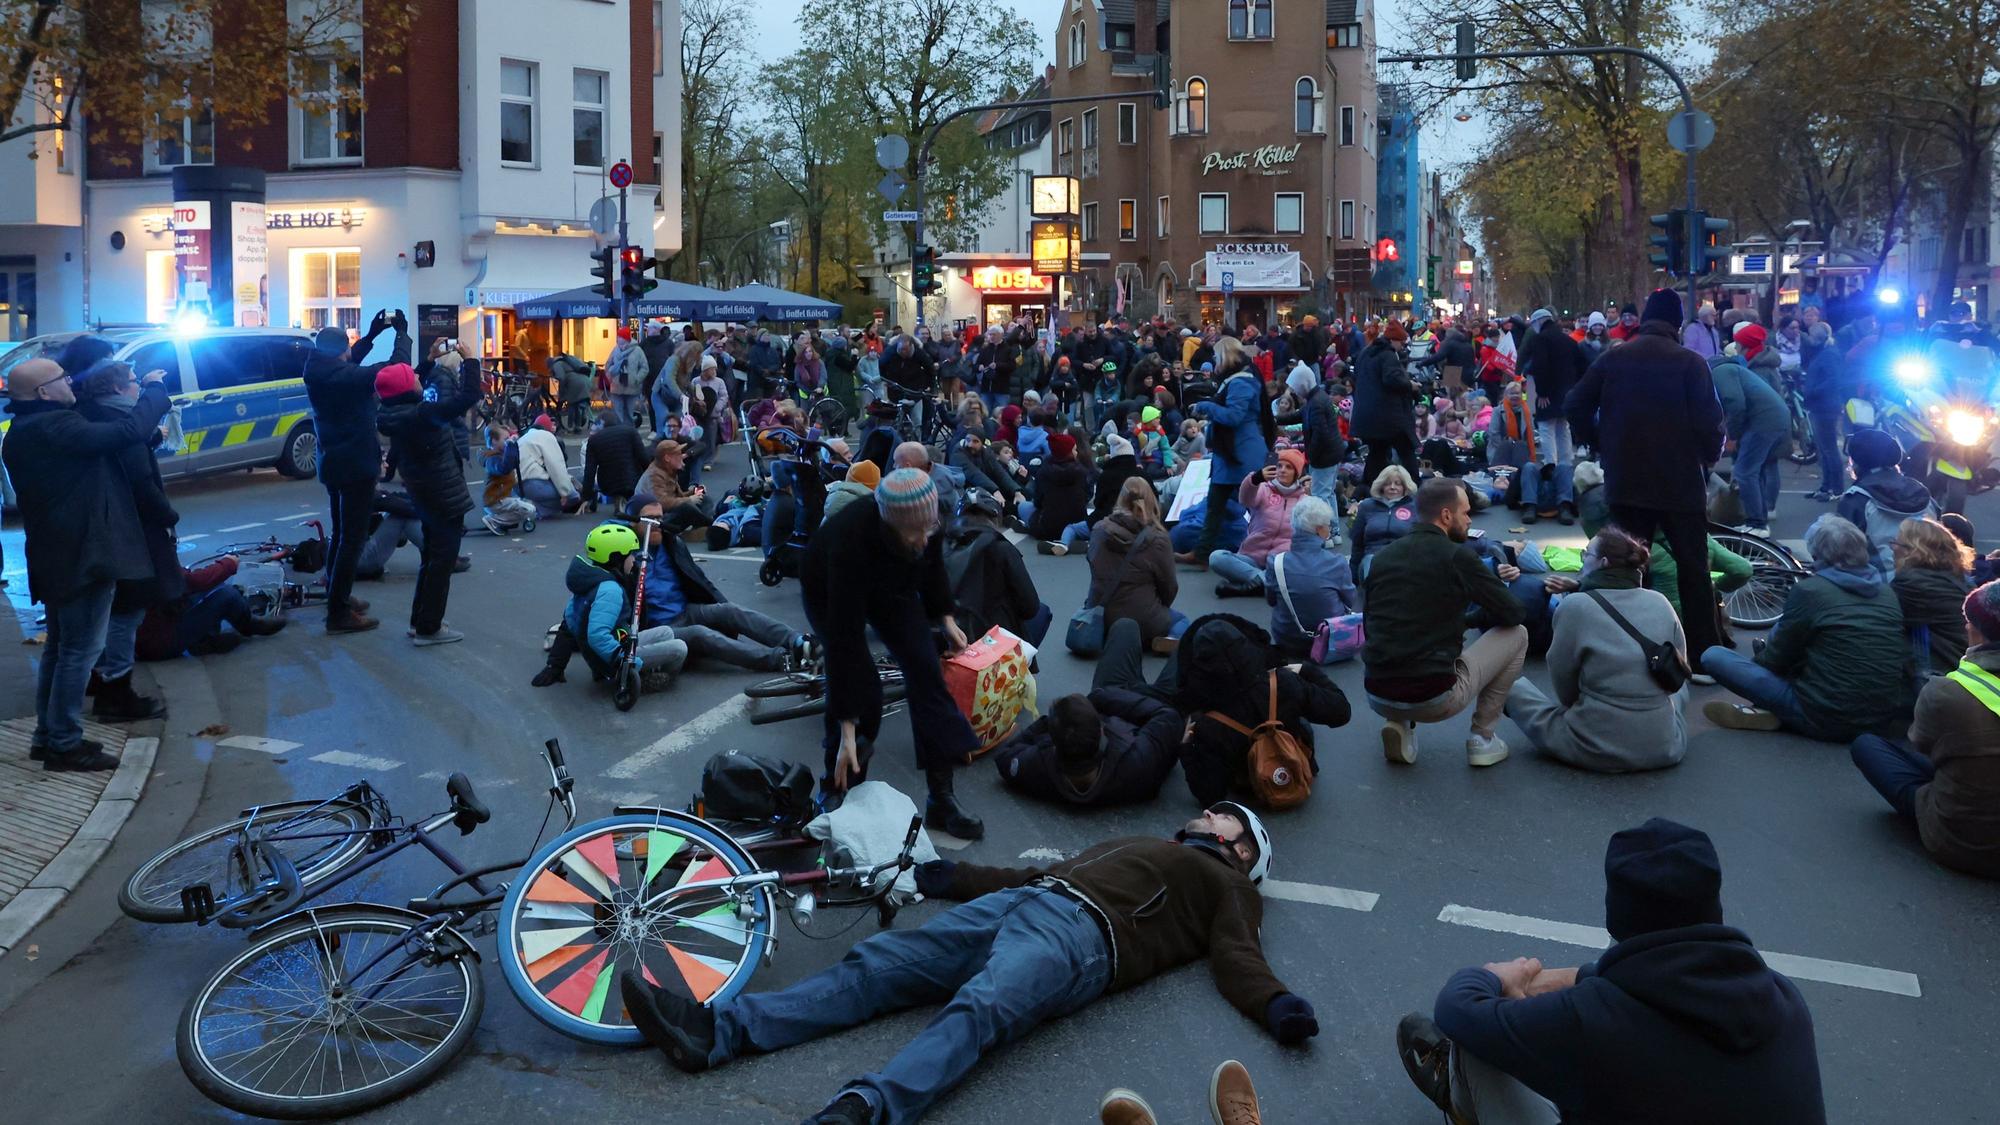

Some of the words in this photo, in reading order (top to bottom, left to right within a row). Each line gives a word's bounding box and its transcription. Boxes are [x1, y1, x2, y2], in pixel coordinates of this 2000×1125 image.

[1253, 143, 1302, 168] Kölle!
[175, 208, 196, 223] TTO
[301, 211, 336, 227] HOF
[1216, 243, 1289, 254] ECKSTEIN
[637, 304, 657, 315] Gaffel
[658, 305, 681, 317] Kölsch
[714, 305, 734, 315] Gaffel
[734, 304, 755, 315] Kölsch
[785, 309, 805, 318] Gaffel
[806, 309, 829, 319] Kölsch
